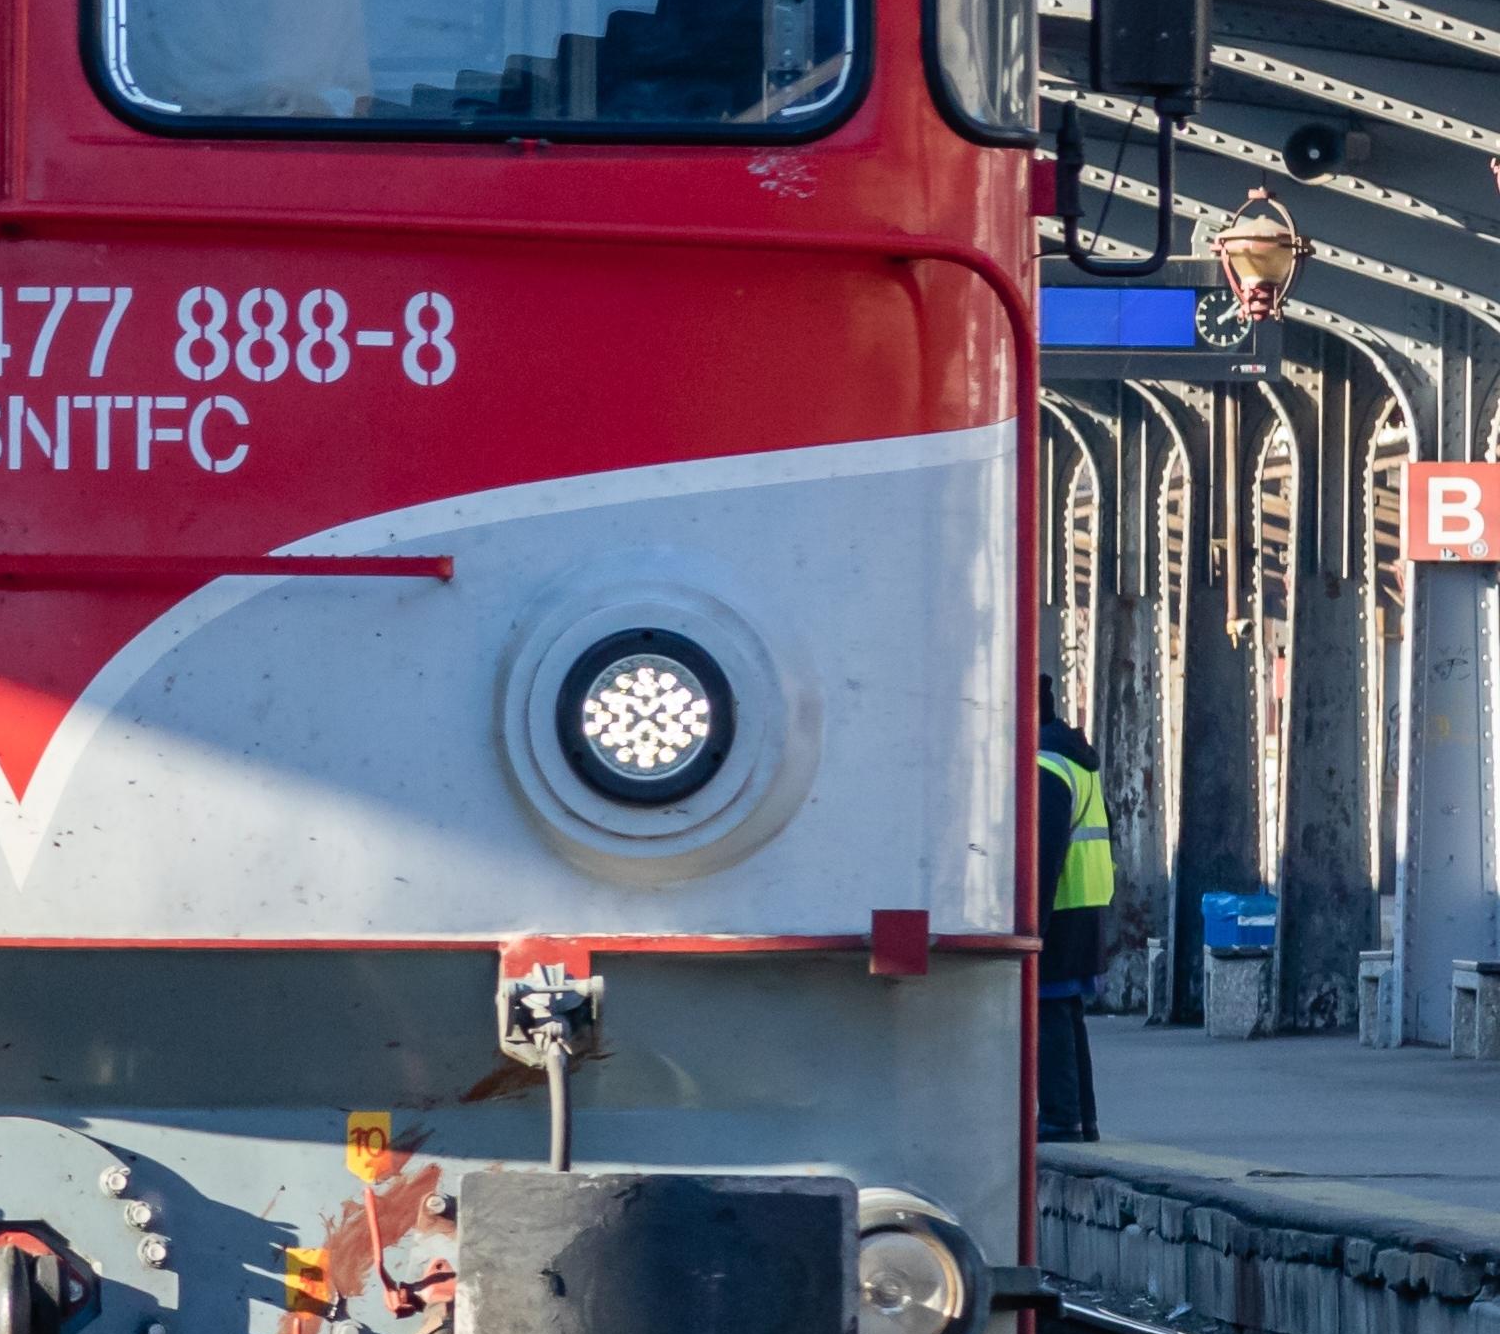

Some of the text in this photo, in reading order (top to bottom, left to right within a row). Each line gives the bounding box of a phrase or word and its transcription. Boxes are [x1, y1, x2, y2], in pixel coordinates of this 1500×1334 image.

[174, 286, 457, 386] 888-8
[1426, 476, 1487, 546] B
[350, 1126, 388, 1158] 10
